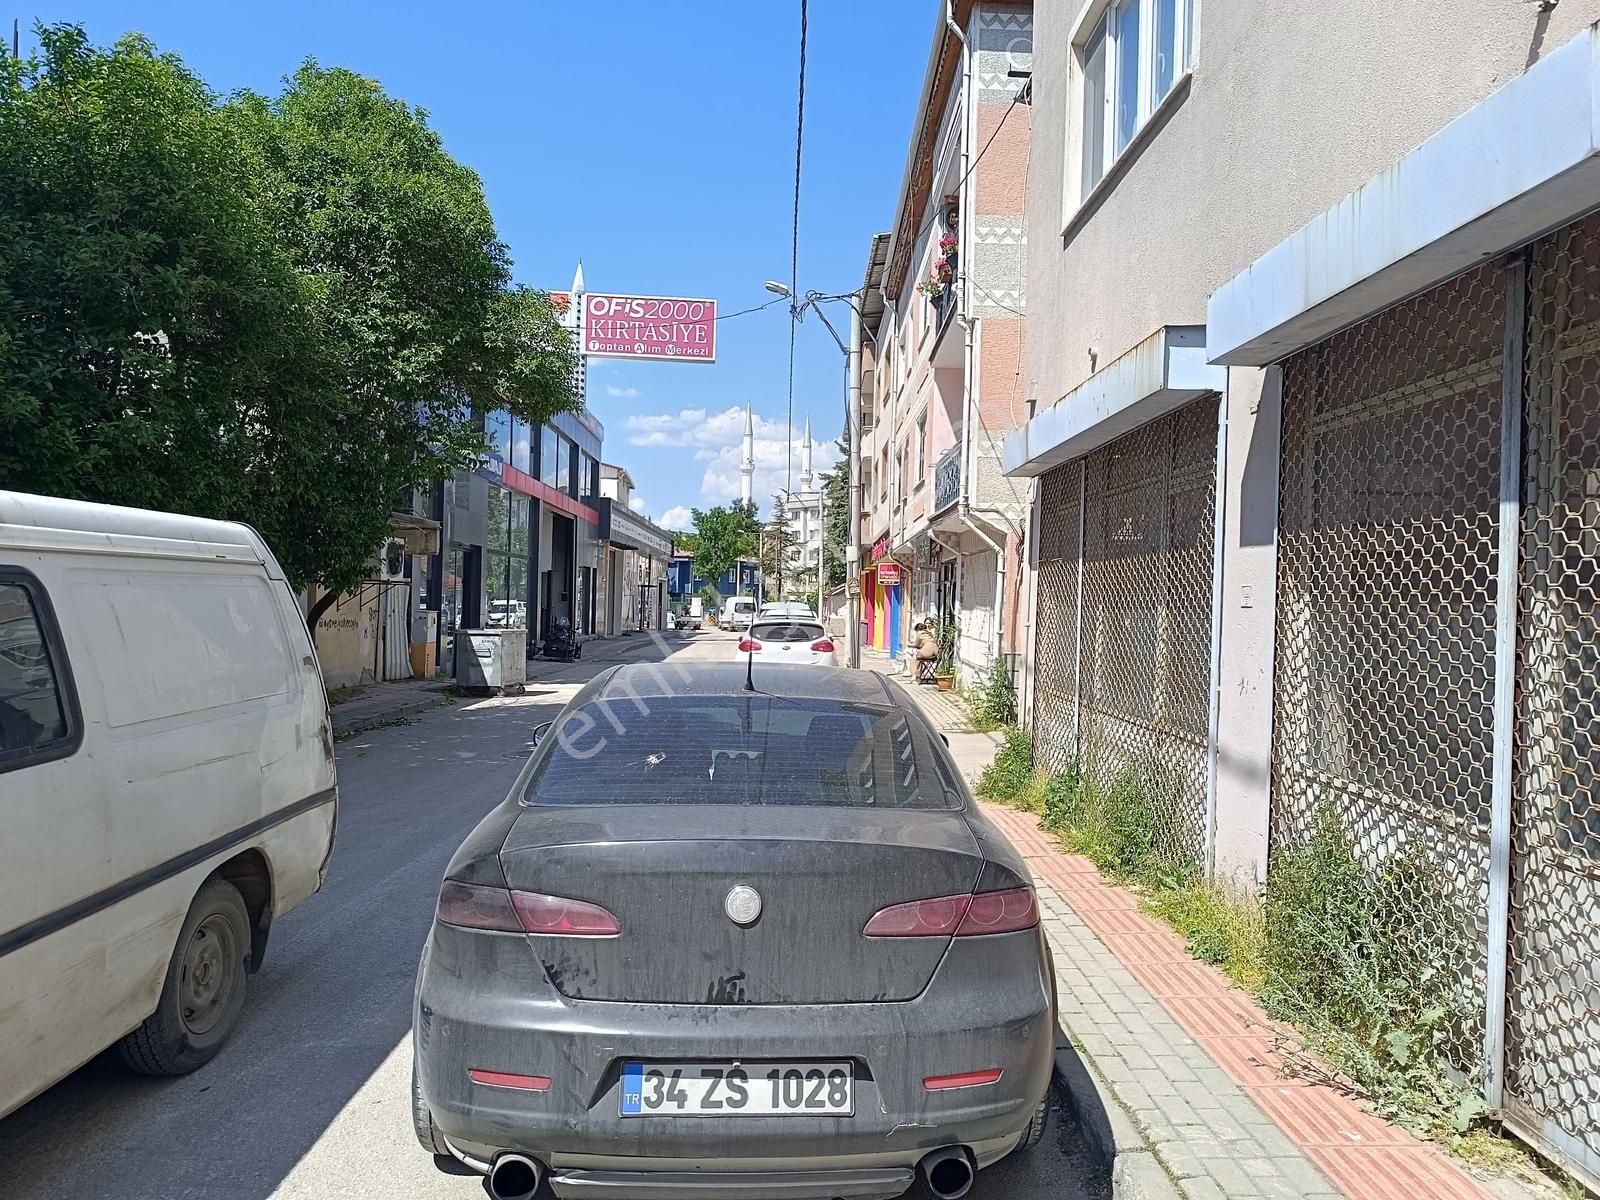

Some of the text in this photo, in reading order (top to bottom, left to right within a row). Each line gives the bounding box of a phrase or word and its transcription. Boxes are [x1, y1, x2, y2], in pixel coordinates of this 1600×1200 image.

[589, 340, 631, 352] Toptan
[665, 344, 709, 356] Merkezi
[643, 1068, 848, 1110] 34 ZS 1028
[624, 1093, 641, 1106] TR
